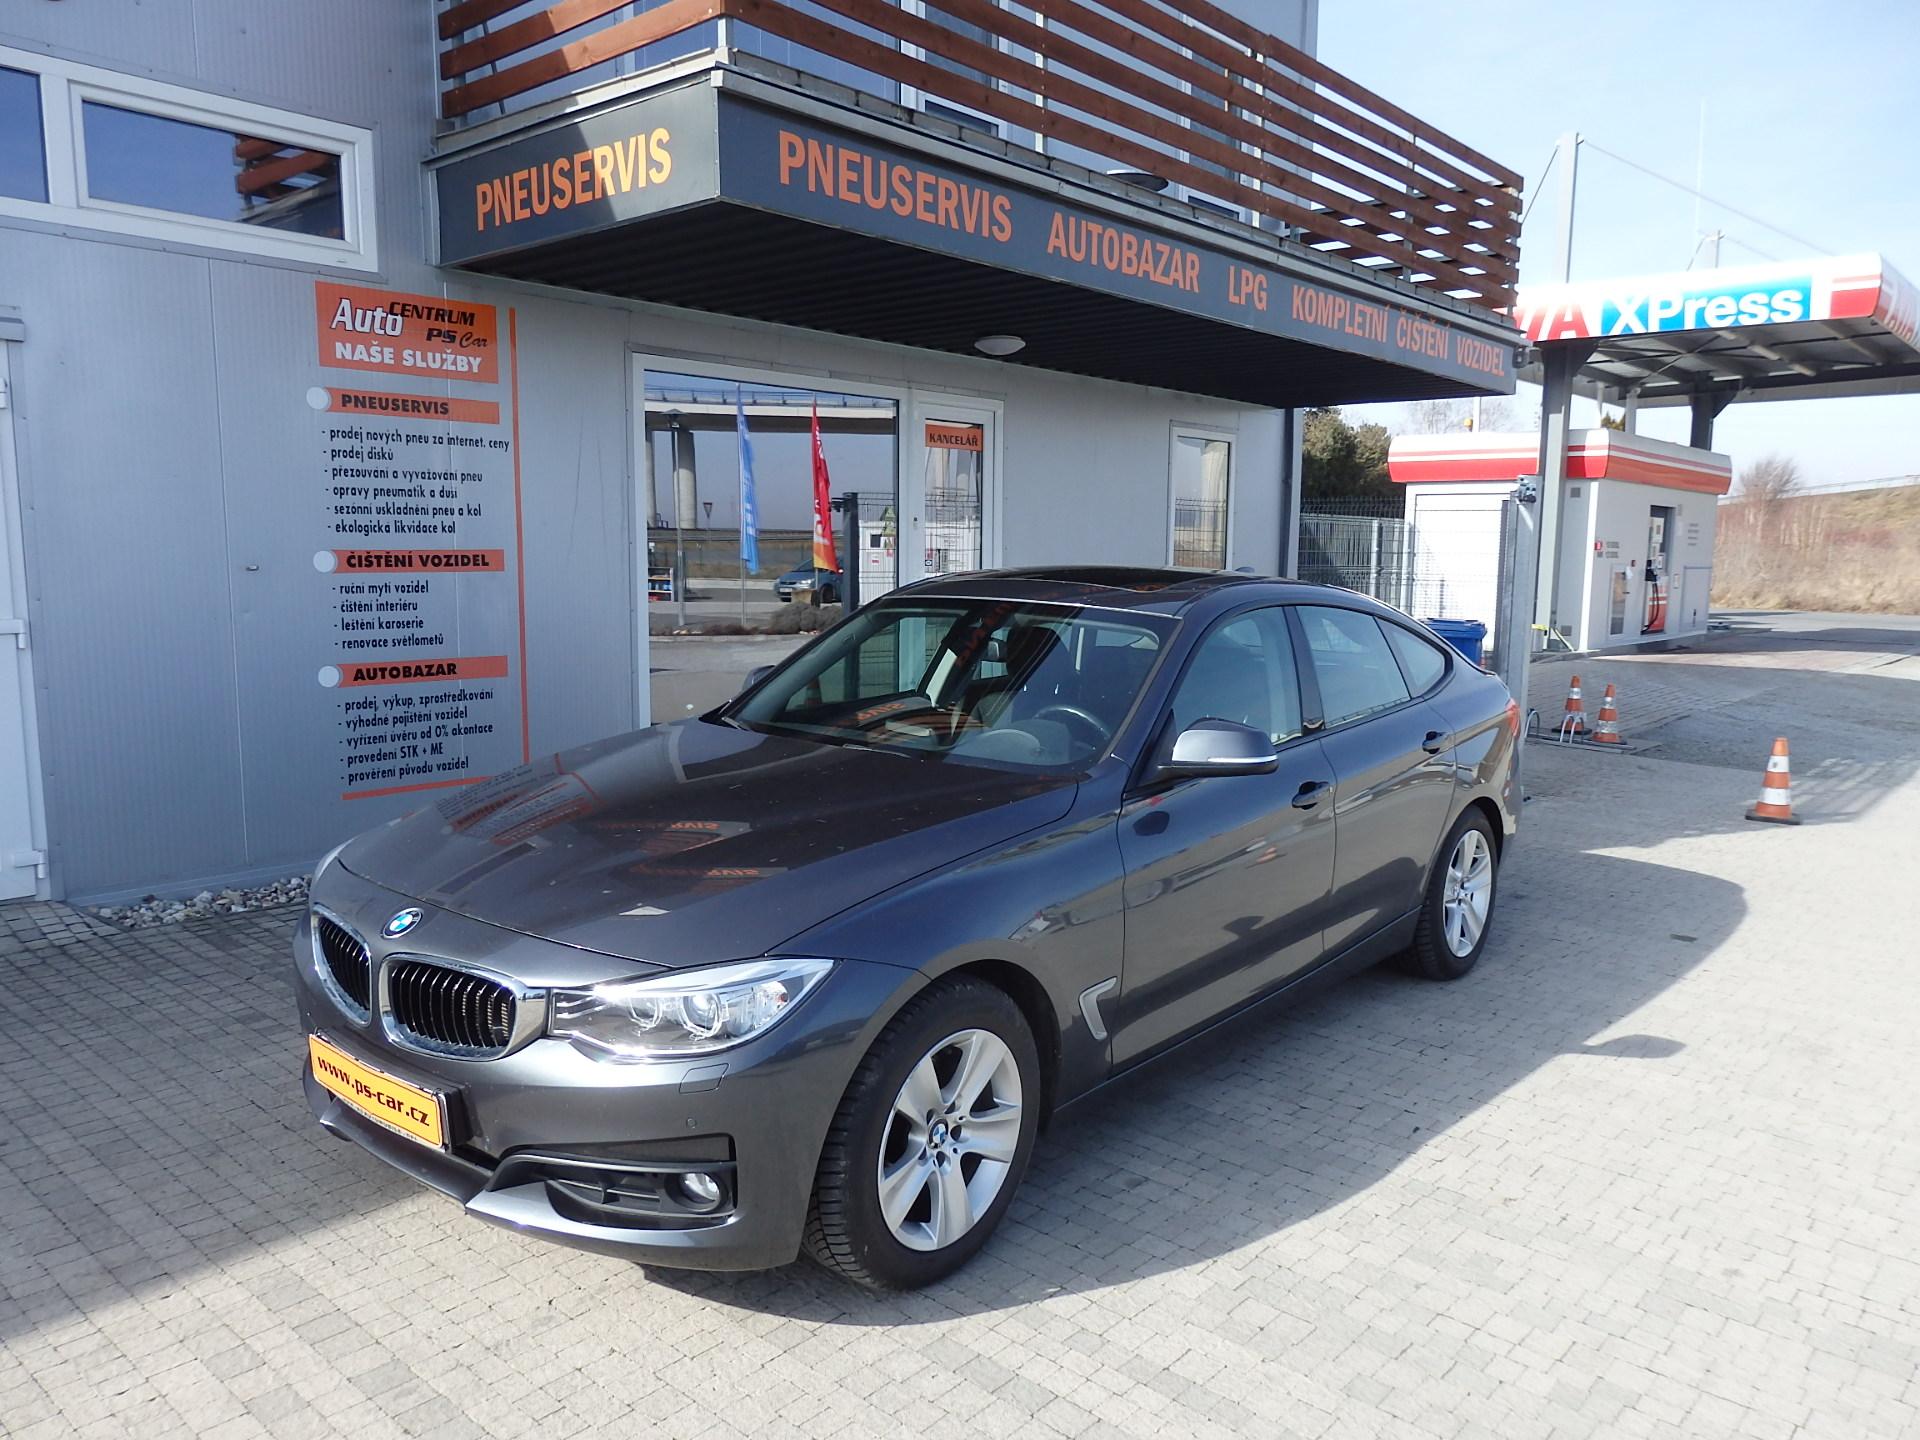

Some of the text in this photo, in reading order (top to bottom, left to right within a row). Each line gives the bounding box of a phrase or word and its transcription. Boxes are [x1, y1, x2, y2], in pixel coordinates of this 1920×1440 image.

[476, 127, 672, 231] PNEUSERVIS
[779, 129, 1505, 377] PNEUSERVIS AUTOBAZAR LPG KOMPLETNÍ ČIŠTĚNÍ VOZIDEL
[331, 298, 475, 337] Auto CENTRUM
[426, 327, 488, 349] PS Car
[335, 340, 481, 373] NAŠE SLUŽBY
[341, 393, 449, 415] PNEUSERVIS
[330, 426, 510, 452] prodej nových pneu za internet. ceny
[331, 445, 364, 463] prodej
[392, 470, 399, 479] a
[460, 472, 483, 484] pneu
[333, 486, 369, 500] opravy
[373, 484, 426, 500] pneumatik
[429, 489, 436, 498] a
[432, 506, 455, 519] pneu
[458, 507, 464, 516] a
[467, 503, 482, 517] kol
[394, 519, 438, 534] likvidace
[441, 520, 456, 534] kol
[346, 551, 489, 568] ČIŠTĚNÍ VOZIDEL
[394, 579, 429, 593] vozidel
[378, 615, 424, 630] karoserie
[342, 638, 389, 650] renovace
[353, 662, 457, 682] AUTOBAZAR
[435, 705, 468, 721] vozidel
[420, 725, 432, 740] od
[451, 723, 494, 736] akontace
[400, 744, 419, 759] STK
[430, 742, 444, 756] ME
[436, 755, 469, 771] vozidel
[317, 1056, 430, 1127] www.ps-car.cz
